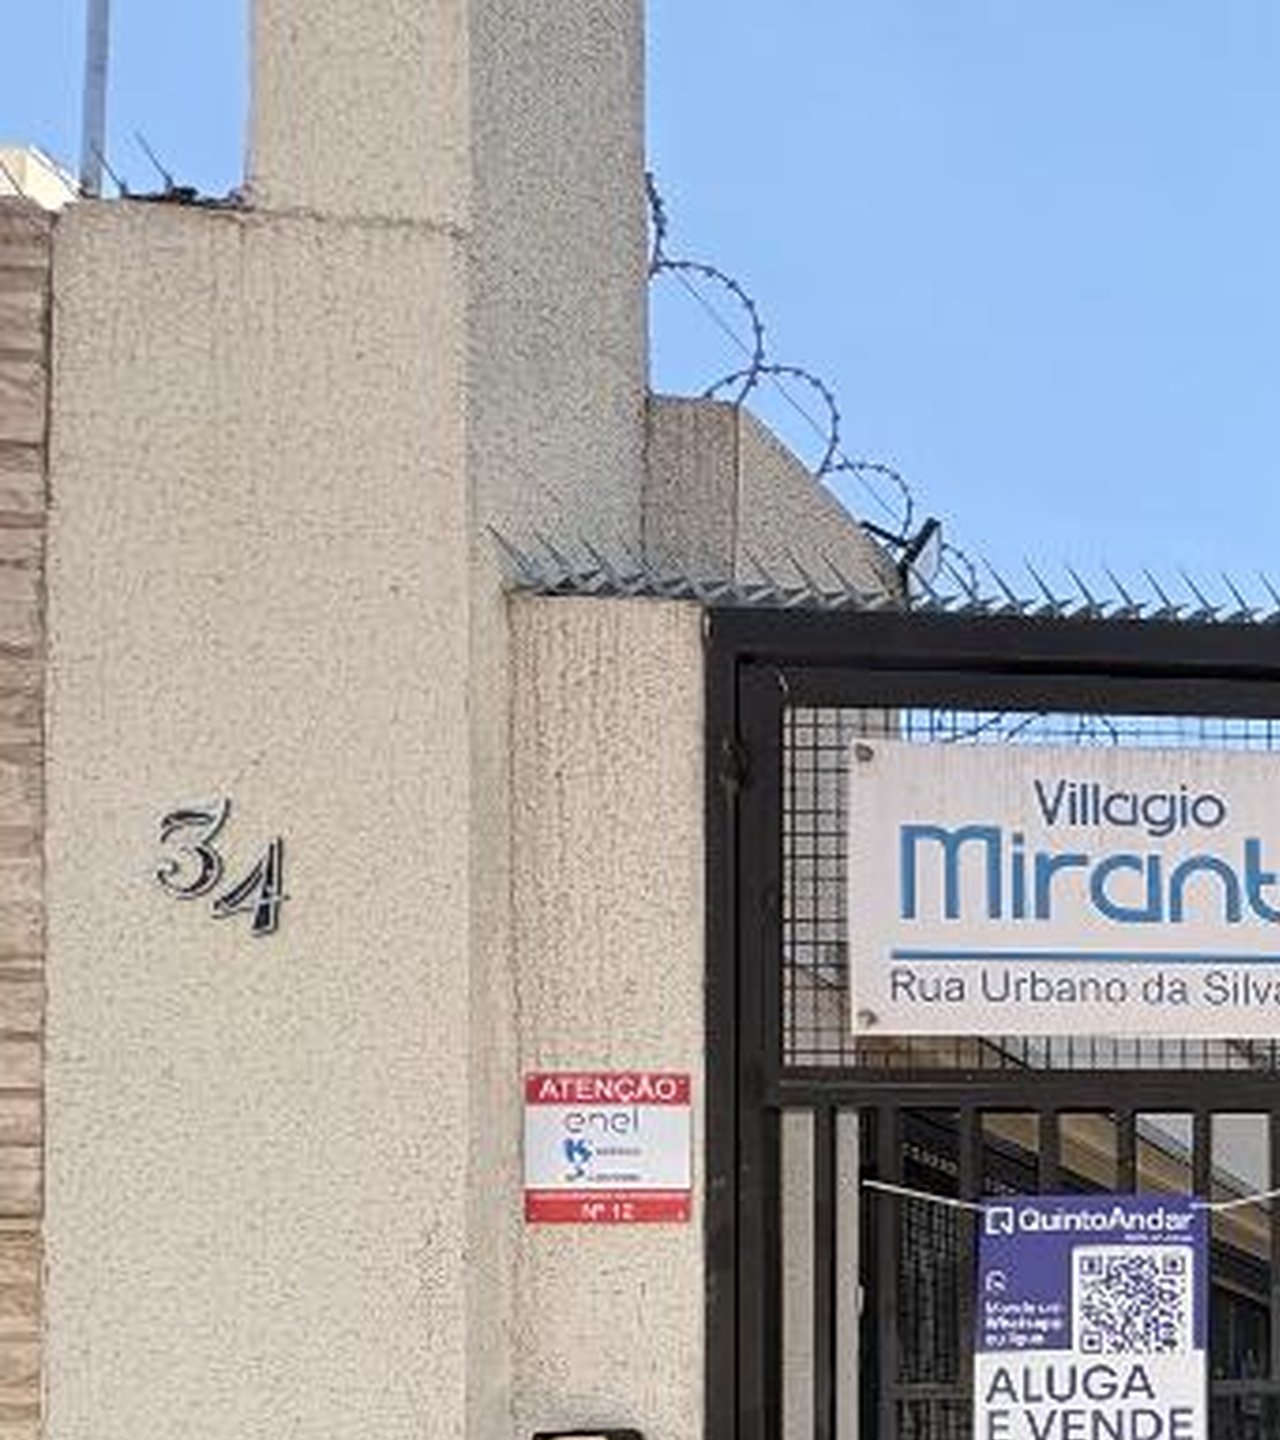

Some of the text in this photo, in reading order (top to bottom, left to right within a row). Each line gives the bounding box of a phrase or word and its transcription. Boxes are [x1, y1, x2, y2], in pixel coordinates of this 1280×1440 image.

[1033, 778, 1226, 837] Villagio
[157, 797, 291, 939] 34
[890, 968, 967, 1003] Rua
[980, 969, 1127, 1005] Urbano
[1141, 971, 1189, 1005] da
[564, 1107, 640, 1134] enel
[1018, 1206, 1196, 1232] QuintoAndar
[985, 1363, 1157, 1404] ALUGA
